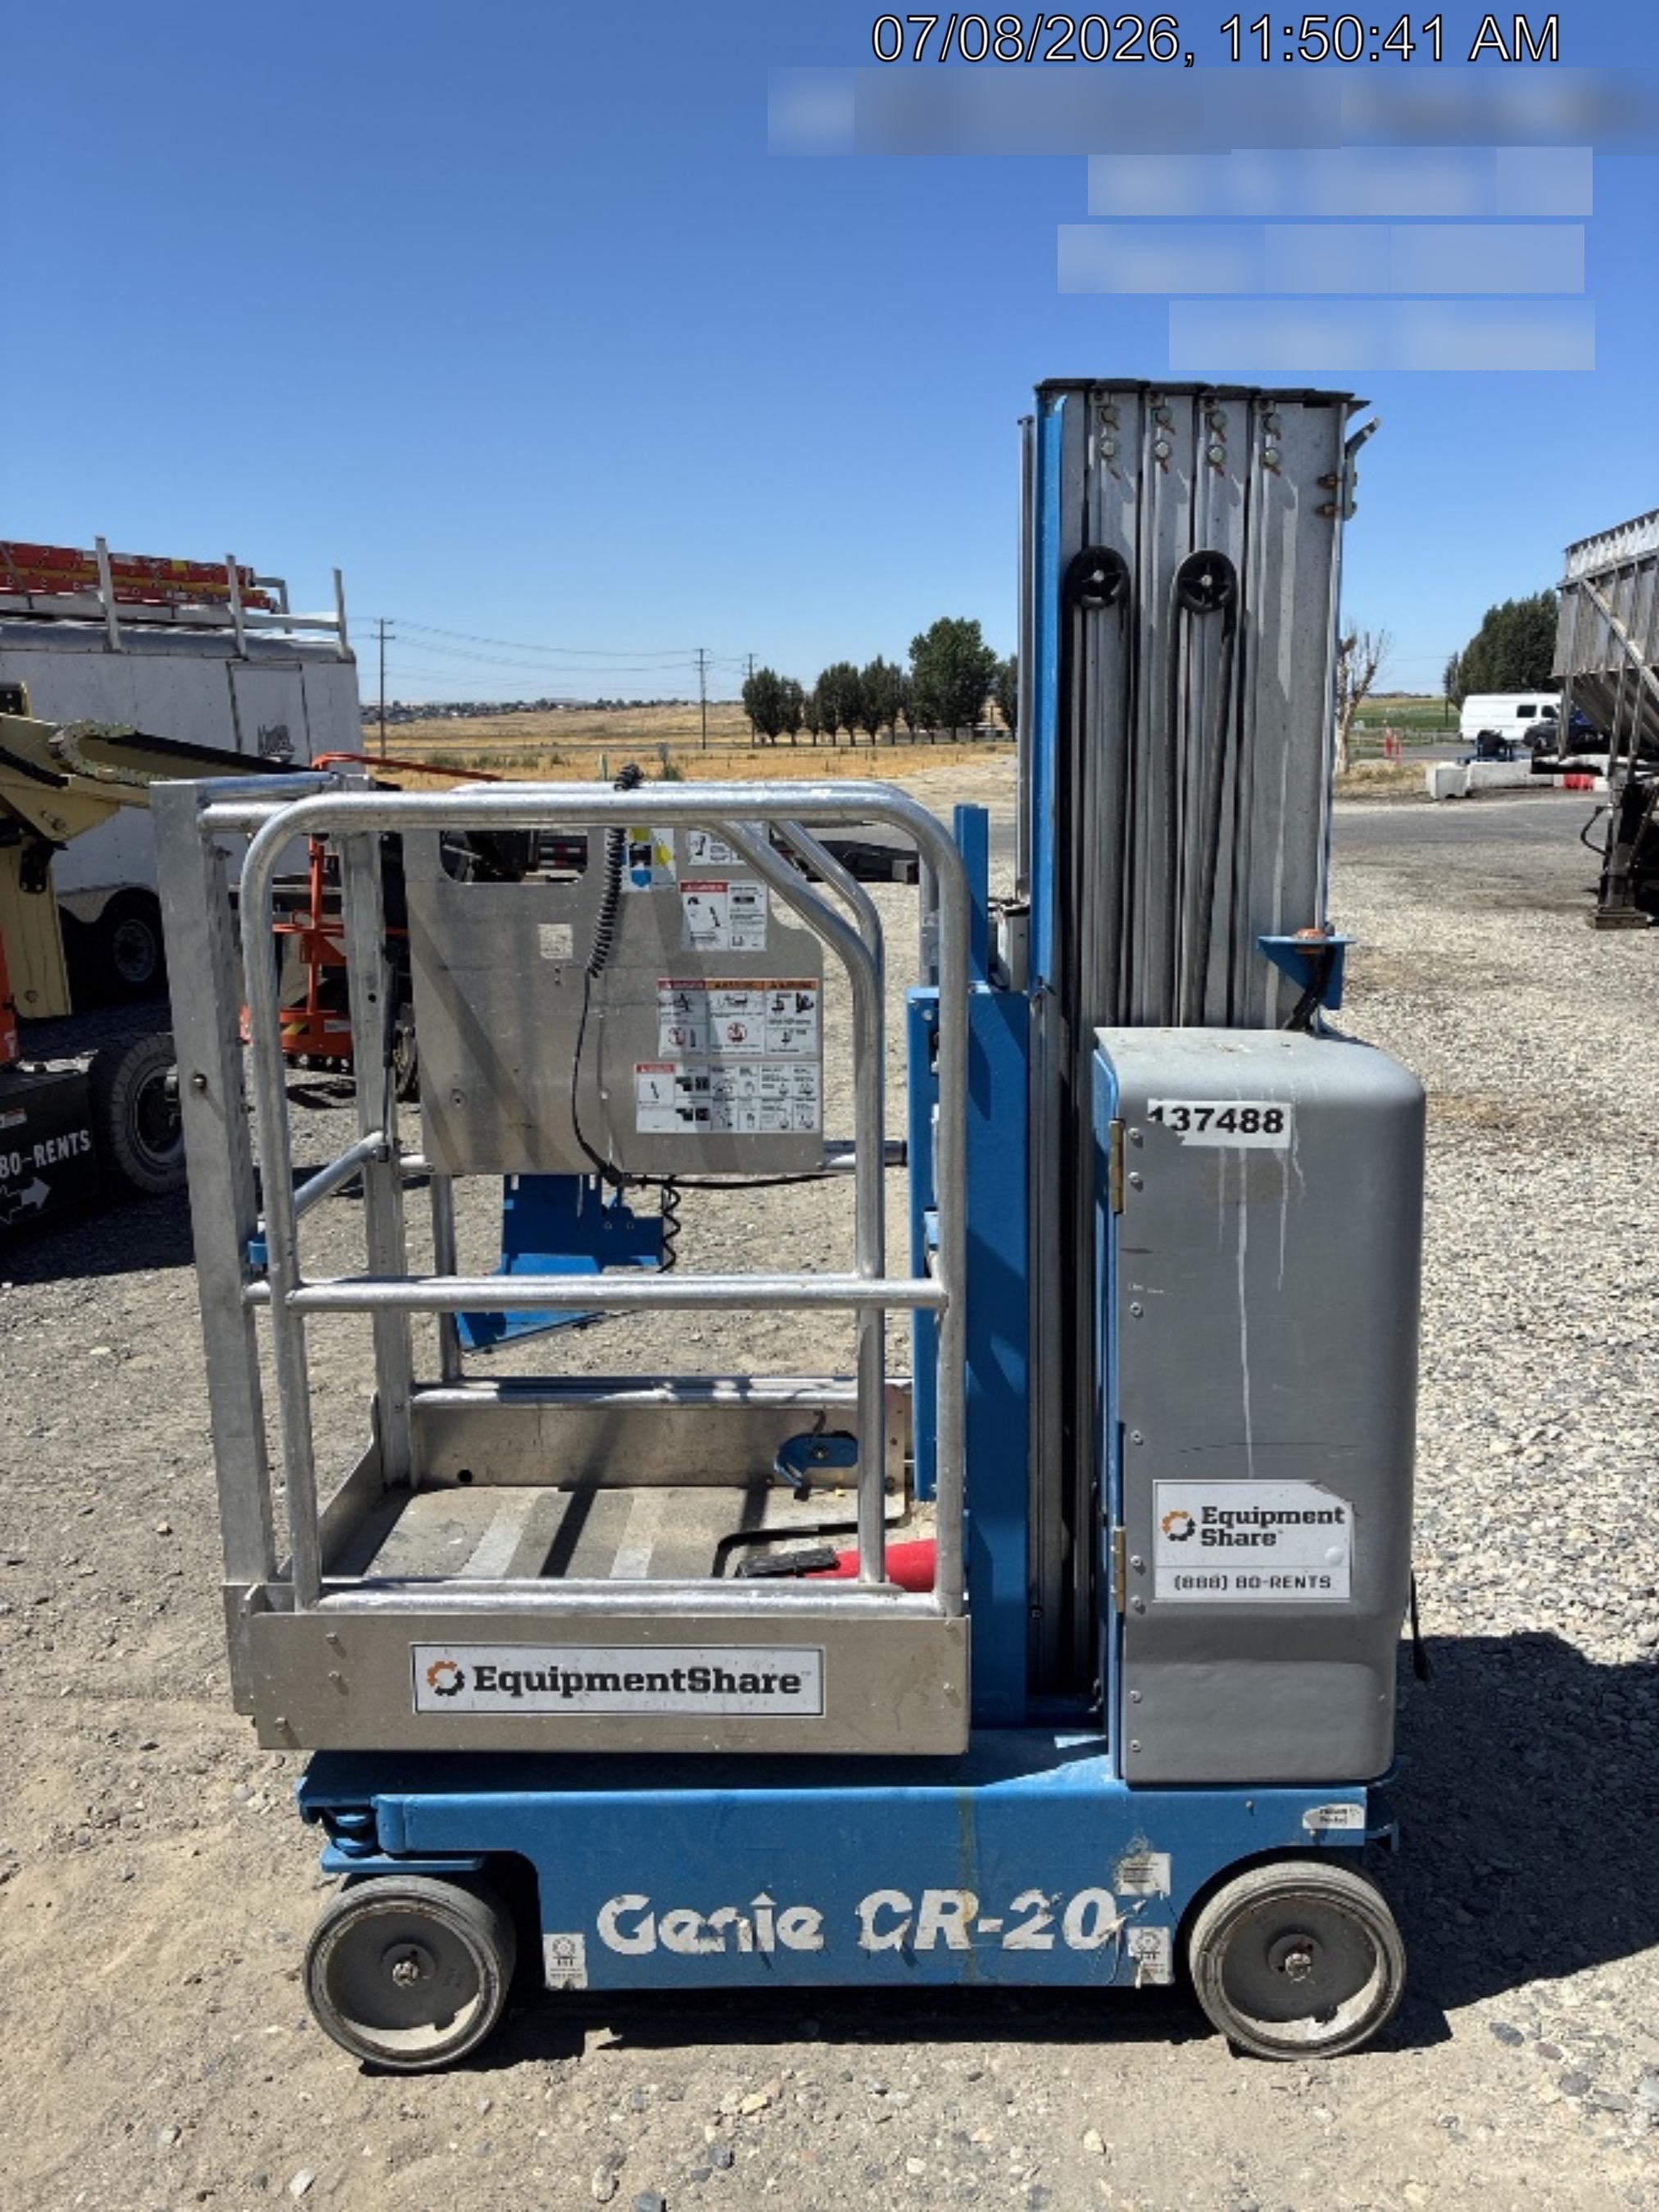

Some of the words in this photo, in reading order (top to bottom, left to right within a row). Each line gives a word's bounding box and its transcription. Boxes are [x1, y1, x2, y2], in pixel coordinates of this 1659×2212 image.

[1149, 1106, 1285, 1135] 137488
[1201, 1506, 1346, 1529] Equipment
[1201, 1528, 1278, 1547] Share
[1174, 1575, 1229, 1591] (888)
[1235, 1575, 1332, 1589] 80-RENTS
[472, 1665, 804, 1698] EquipmentShare
[596, 1891, 826, 1955] Genie
[855, 1888, 1117, 1953] CR-20
